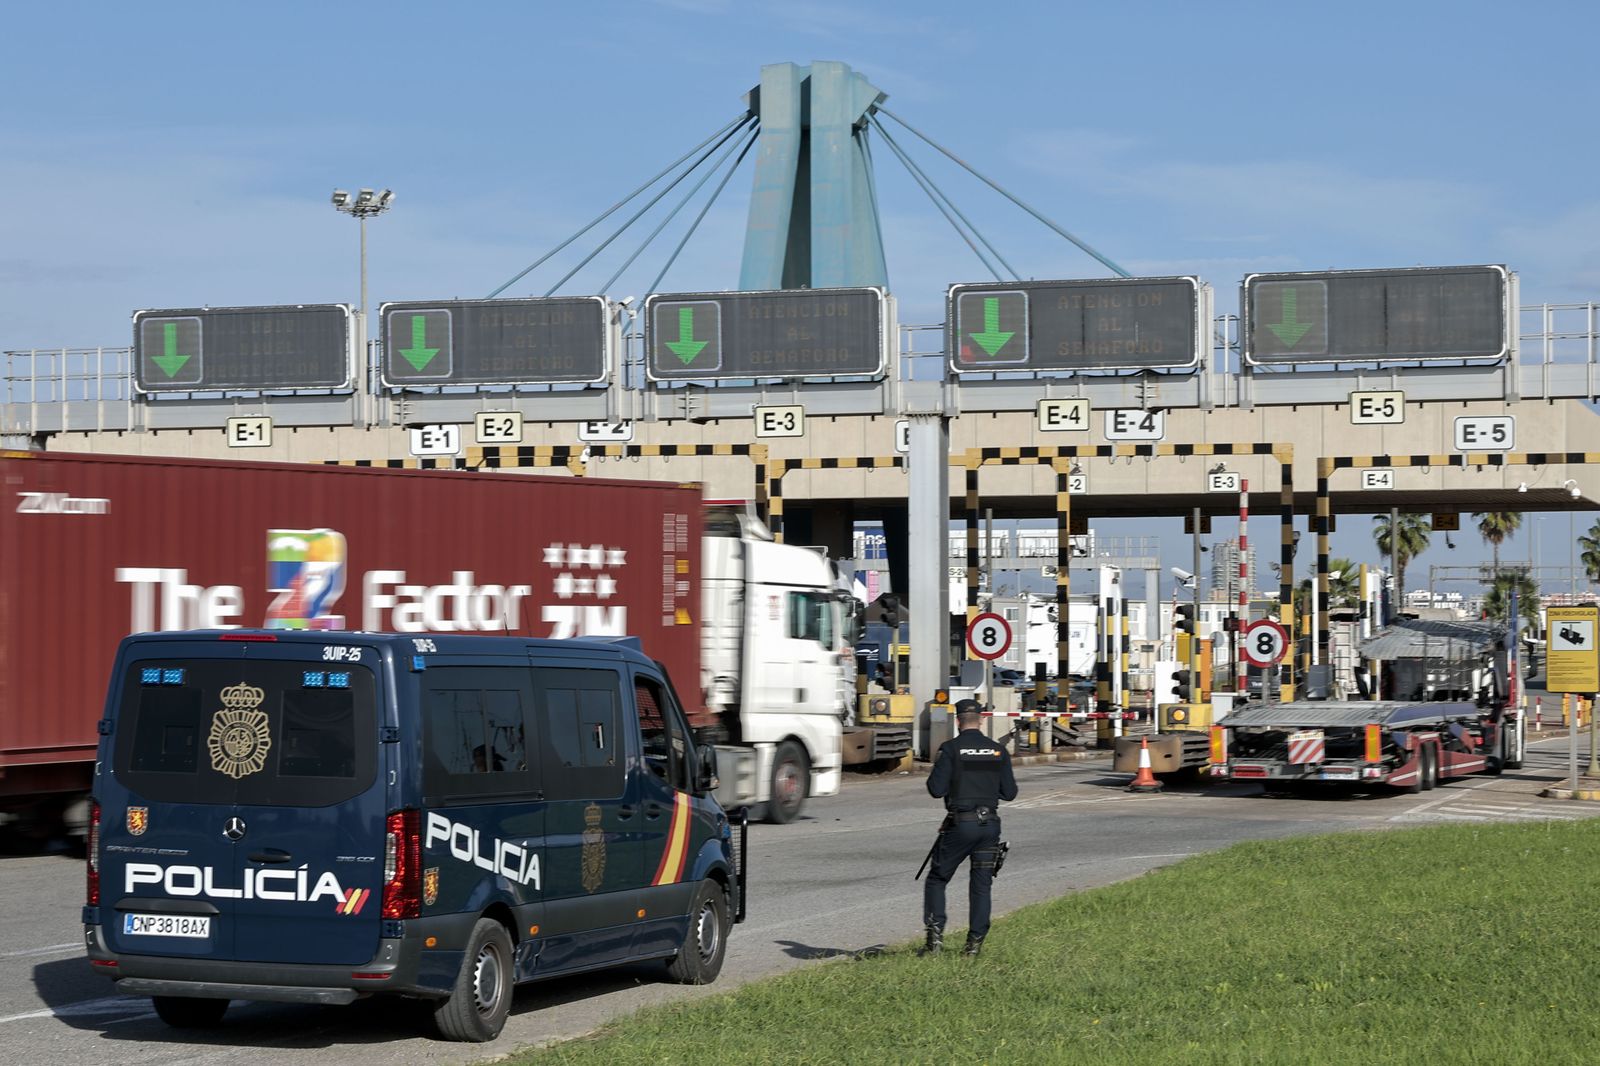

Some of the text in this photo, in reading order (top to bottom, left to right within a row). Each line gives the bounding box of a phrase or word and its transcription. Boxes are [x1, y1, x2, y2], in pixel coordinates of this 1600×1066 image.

[750, 303, 848, 319] ATENCION
[1057, 292, 1162, 311] ATENCION
[1057, 338, 1162, 356] SEMAFORO
[1047, 405, 1080, 425] E-4
[1360, 398, 1395, 418] E-5
[484, 418, 513, 437] E-2
[764, 412, 795, 431] E-3
[1114, 413, 1156, 433] E-4
[236, 423, 263, 441] E-1
[421, 430, 450, 449] E-1
[1463, 423, 1506, 443] E-5
[1069, 478, 1082, 490] -2
[1213, 476, 1234, 488] E-3
[1367, 474, 1389, 486] E-4
[114, 567, 244, 632] The
[362, 570, 532, 634] Factor
[982, 626, 996, 647] 8
[1257, 632, 1274, 655] 8
[322, 646, 362, 661] 3UIP-25
[425, 812, 541, 890] POLICÍA
[125, 863, 347, 902] POLICÍA
[132, 916, 208, 935] CNP3818AX
